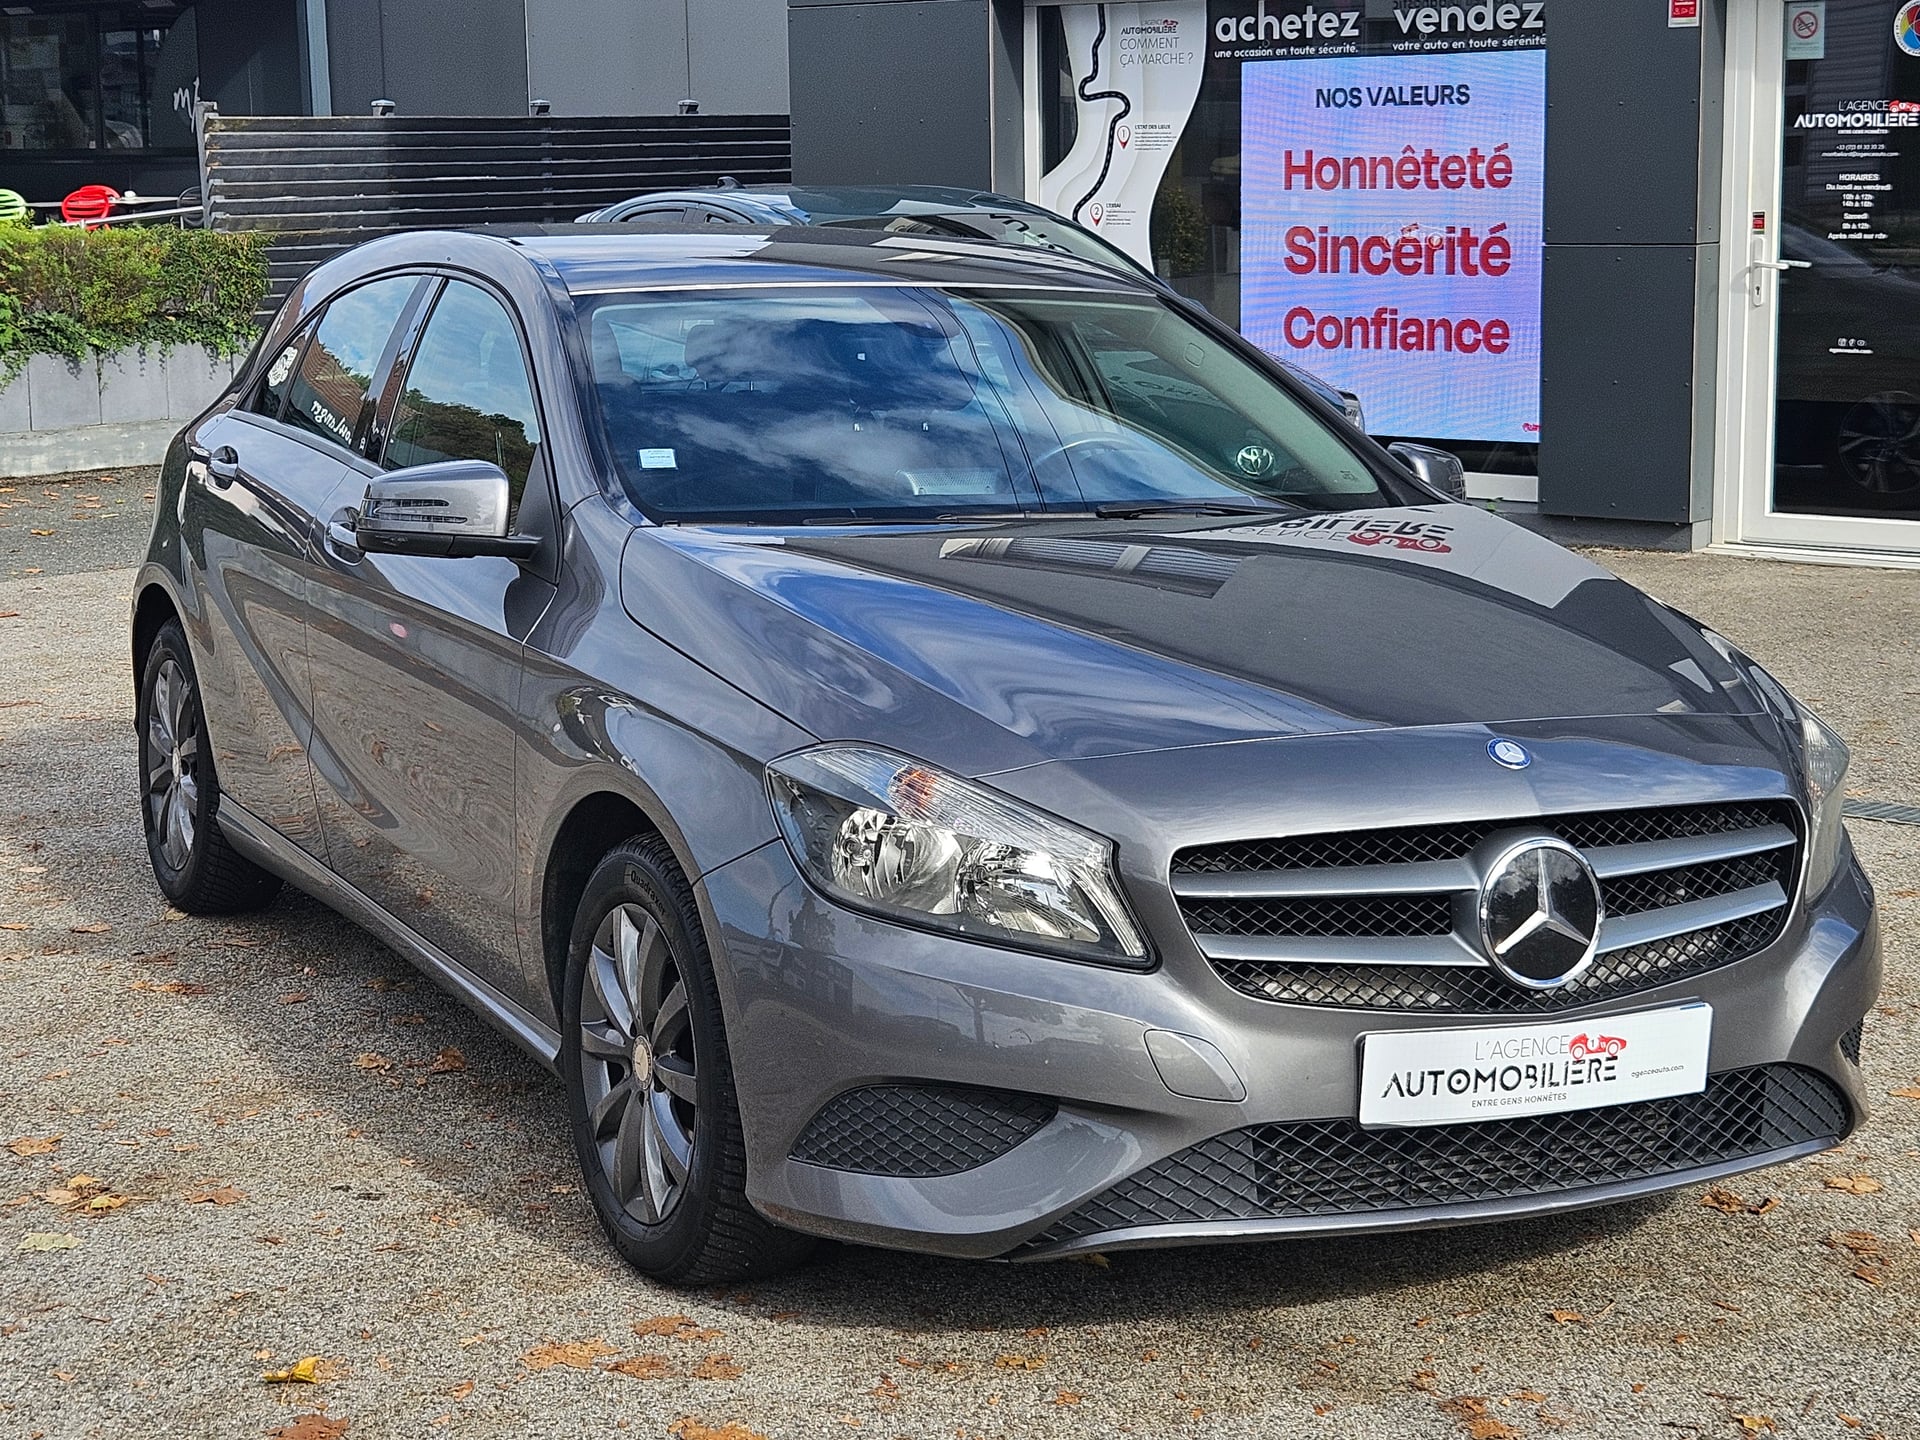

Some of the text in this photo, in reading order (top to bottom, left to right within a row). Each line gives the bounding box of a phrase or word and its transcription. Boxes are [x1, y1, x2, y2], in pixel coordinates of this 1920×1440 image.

[1215, 0, 1360, 42] achetez
[1393, 0, 1545, 34] vendez
[1120, 36, 1180, 50] COMMENT
[1214, 42, 1359, 58] une occasion en toute sécurité.
[1393, 33, 1547, 51] votre auto en toute sérénité
[1120, 51, 1194, 68] ÇA MARCHE ?
[1316, 84, 1471, 108] NOS VALEURS
[1838, 100, 1889, 111] L'AGENCE
[1283, 142, 1513, 191] Honnêteté
[1839, 173, 1880, 181] HORAIRES
[1283, 222, 1512, 277] Sincérité
[1283, 306, 1510, 355] Confiance
[1475, 1034, 1570, 1061] L'AGENCE
[1631, 1063, 1685, 1078] agenceauto.com
[1471, 1091, 1568, 1108] ENTRE GENS HONNÊTES
